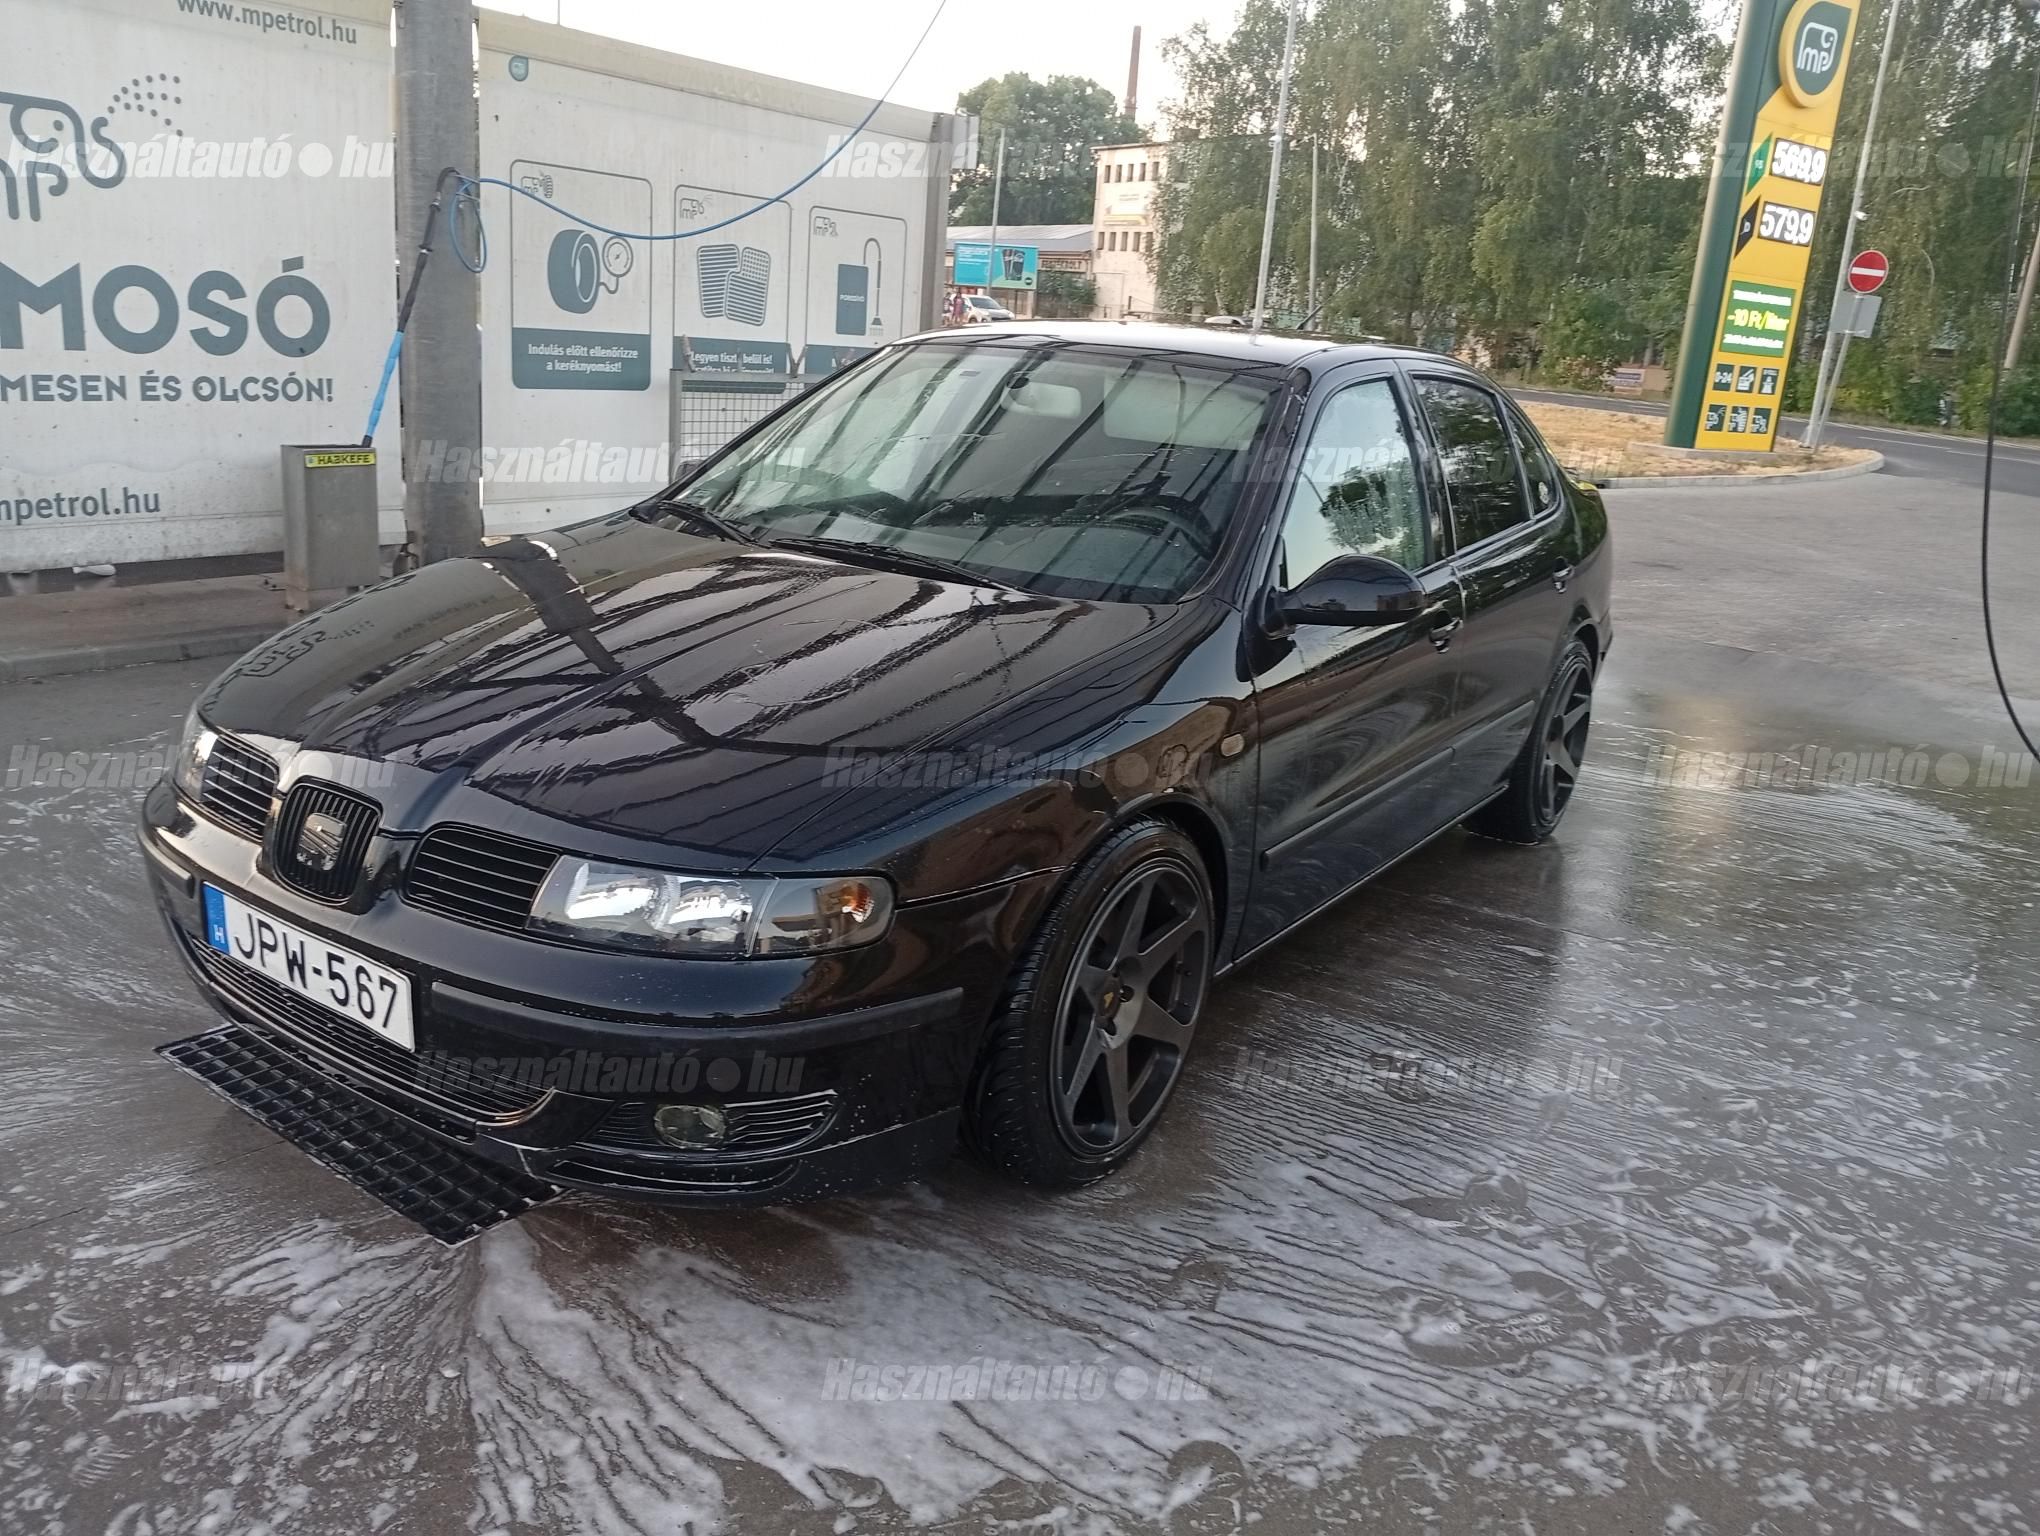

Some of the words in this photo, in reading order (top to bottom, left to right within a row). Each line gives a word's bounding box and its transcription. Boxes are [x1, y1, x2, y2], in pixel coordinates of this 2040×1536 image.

[177, 0, 357, 44] www.mpetrol.hu
[0, 256, 331, 358] MOSÓ
[527, 343, 564, 356] Indulás
[566, 344, 588, 357] előtt
[589, 346, 639, 359] ellenőrizze
[546, 361, 553, 371] a
[554, 360, 622, 374] keréknyomást!
[691, 351, 719, 364] Legyen
[720, 352, 740, 363] tiszt
[139, 370, 182, 402] ÉS
[192, 371, 334, 403] OLCSÓN!
[214, 924, 226, 944] H
[234, 913, 398, 1029] JPW-567
